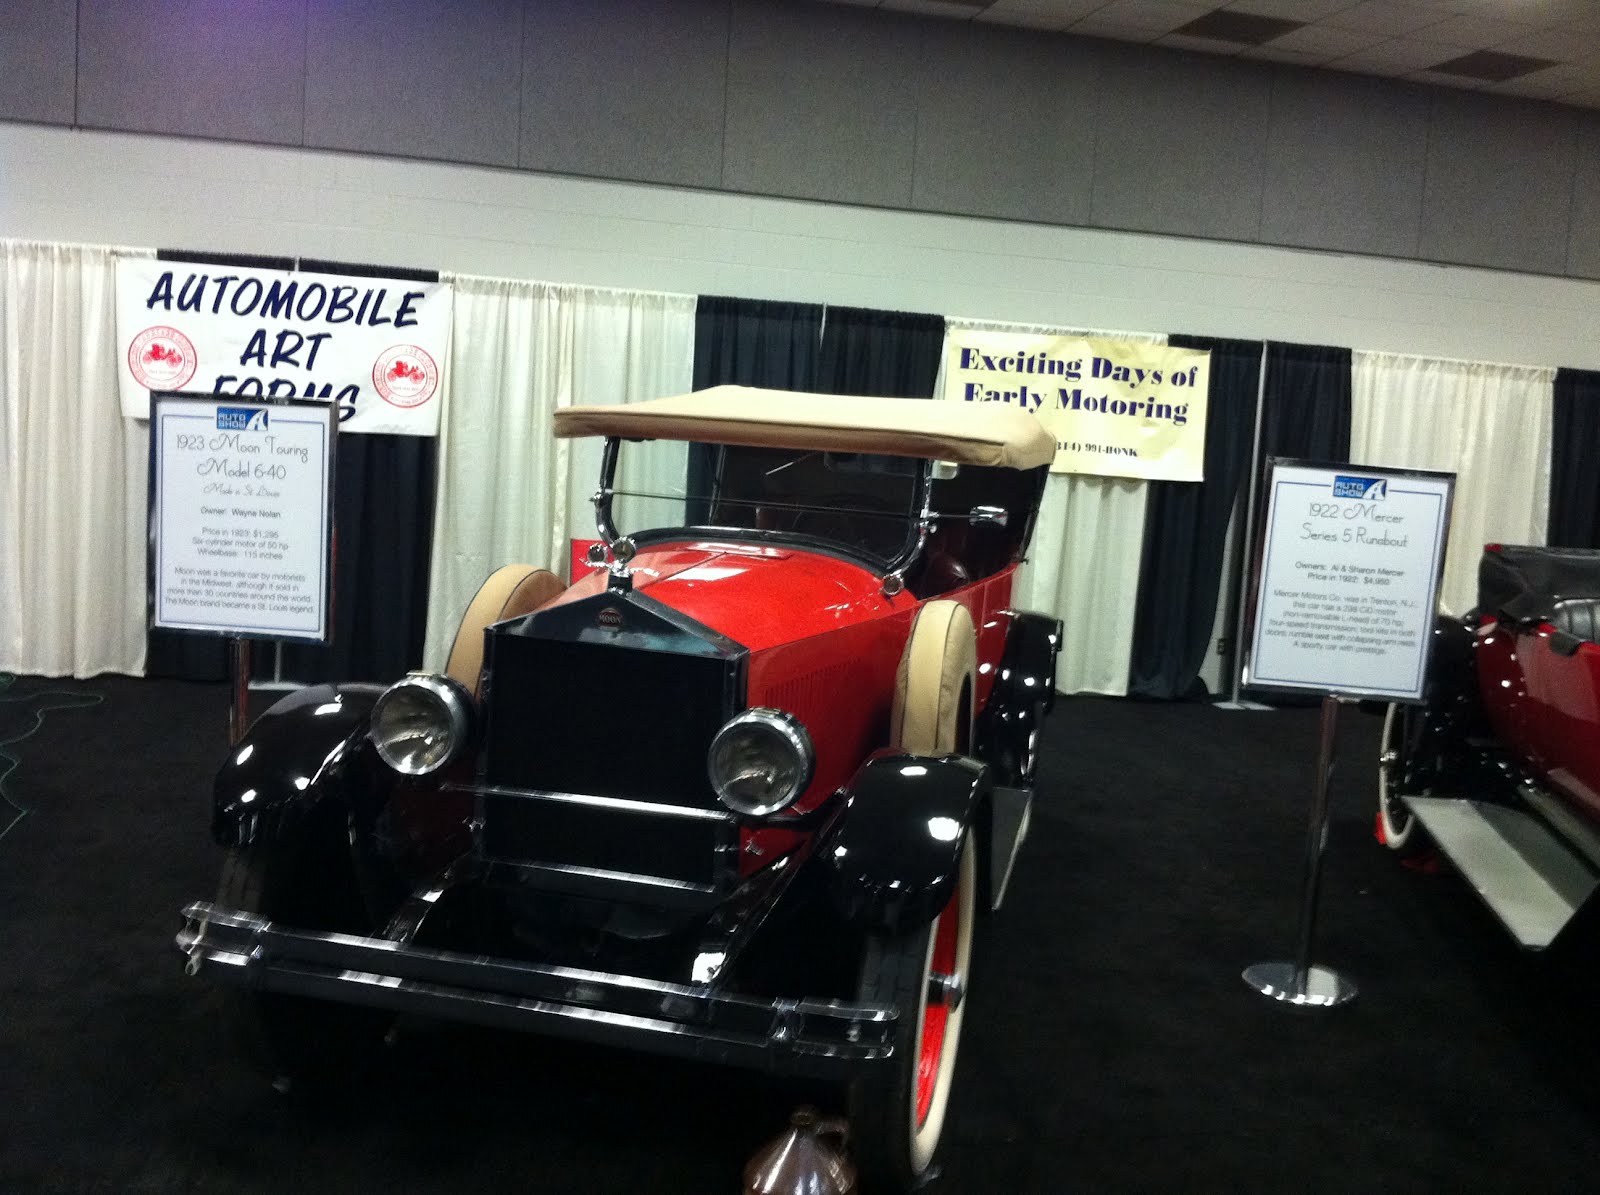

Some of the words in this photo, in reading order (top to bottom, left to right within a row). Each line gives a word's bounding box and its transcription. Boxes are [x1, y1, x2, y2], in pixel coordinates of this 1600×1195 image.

[146, 271, 425, 328] AUTOMOBILE
[240, 328, 332, 371] ART
[960, 347, 1083, 382] Exciting
[1091, 357, 1163, 389] Days
[1171, 366, 1198, 388] of
[964, 382, 1047, 413] Early
[1056, 388, 1189, 426] Motoring
[218, 412, 246, 421] AUTO
[218, 420, 246, 429] SHOW
[176, 434, 205, 450] 1923
[209, 433, 260, 453] Moon
[264, 436, 308, 463] Touring
[1056, 441, 1081, 452] 314)
[197, 457, 250, 478] Model
[254, 463, 286, 480] 6-40
[1335, 482, 1363, 490] AUTO
[1334, 488, 1363, 497] SHOW
[232, 508, 257, 518] Wayne
[259, 510, 281, 519] Nolan
[1309, 503, 1338, 519] 1922
[1343, 503, 1404, 523] Mercer
[202, 527, 221, 536] Price
[222, 528, 229, 536] in
[1299, 522, 1337, 542] Series
[1343, 528, 1352, 543] 5
[1355, 526, 1408, 548] Runabout
[235, 540, 256, 548] motor
[257, 540, 266, 549] of
[259, 551, 283, 560] inches
[1308, 572, 1327, 580] Price
[1340, 564, 1346, 573] &
[1348, 565, 1376, 575] Sharon
[1377, 568, 1405, 577] Mercer
[260, 572, 271, 582] by
[236, 581, 267, 591] although
[187, 588, 201, 596] than
[250, 591, 275, 600] around
[599, 614, 621, 623] MOON
